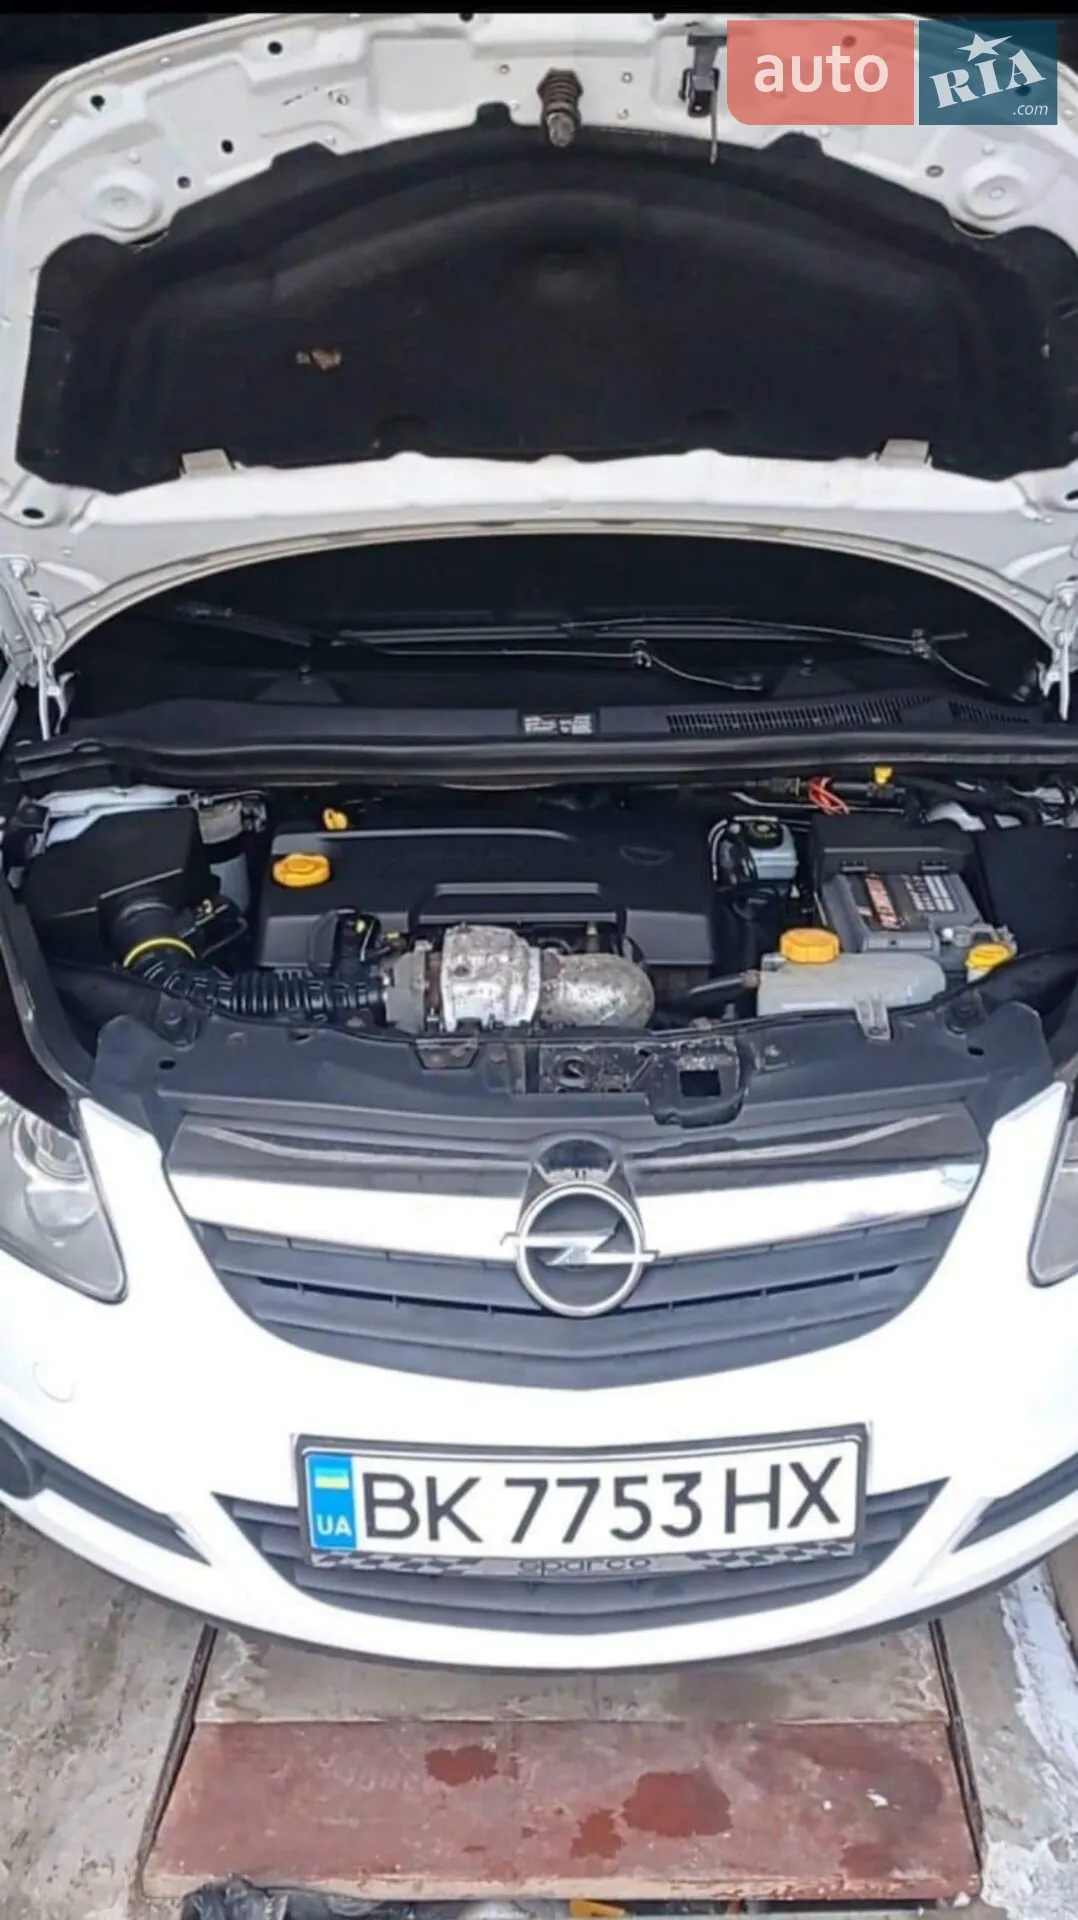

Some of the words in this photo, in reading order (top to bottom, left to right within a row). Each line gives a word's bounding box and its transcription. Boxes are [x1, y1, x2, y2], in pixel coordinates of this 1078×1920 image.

[316, 1513, 352, 1537] UA
[362, 1472, 483, 1543] BK
[504, 1471, 702, 1543] 7753
[723, 1457, 842, 1534] HX
